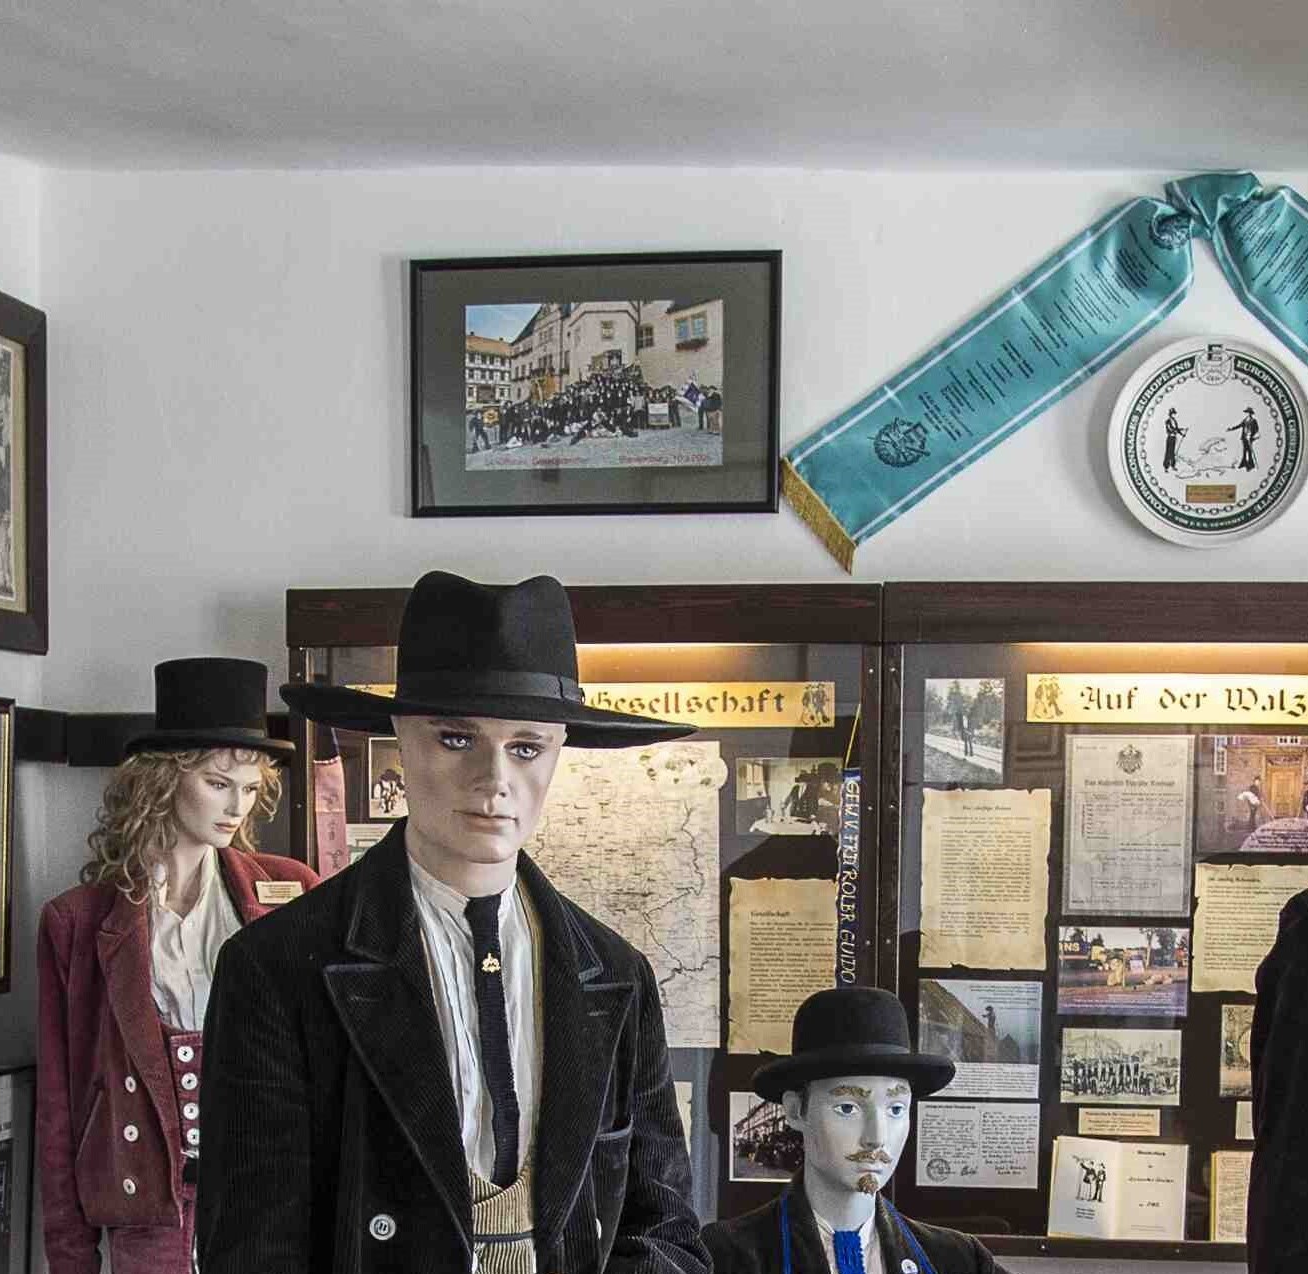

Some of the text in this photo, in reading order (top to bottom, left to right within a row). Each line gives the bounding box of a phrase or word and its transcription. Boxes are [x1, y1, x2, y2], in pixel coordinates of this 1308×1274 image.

[591, 689, 786, 715] Gesellschaft
[1080, 686, 1308, 717] Auf der Walz
[841, 929, 857, 985] GUIDO
